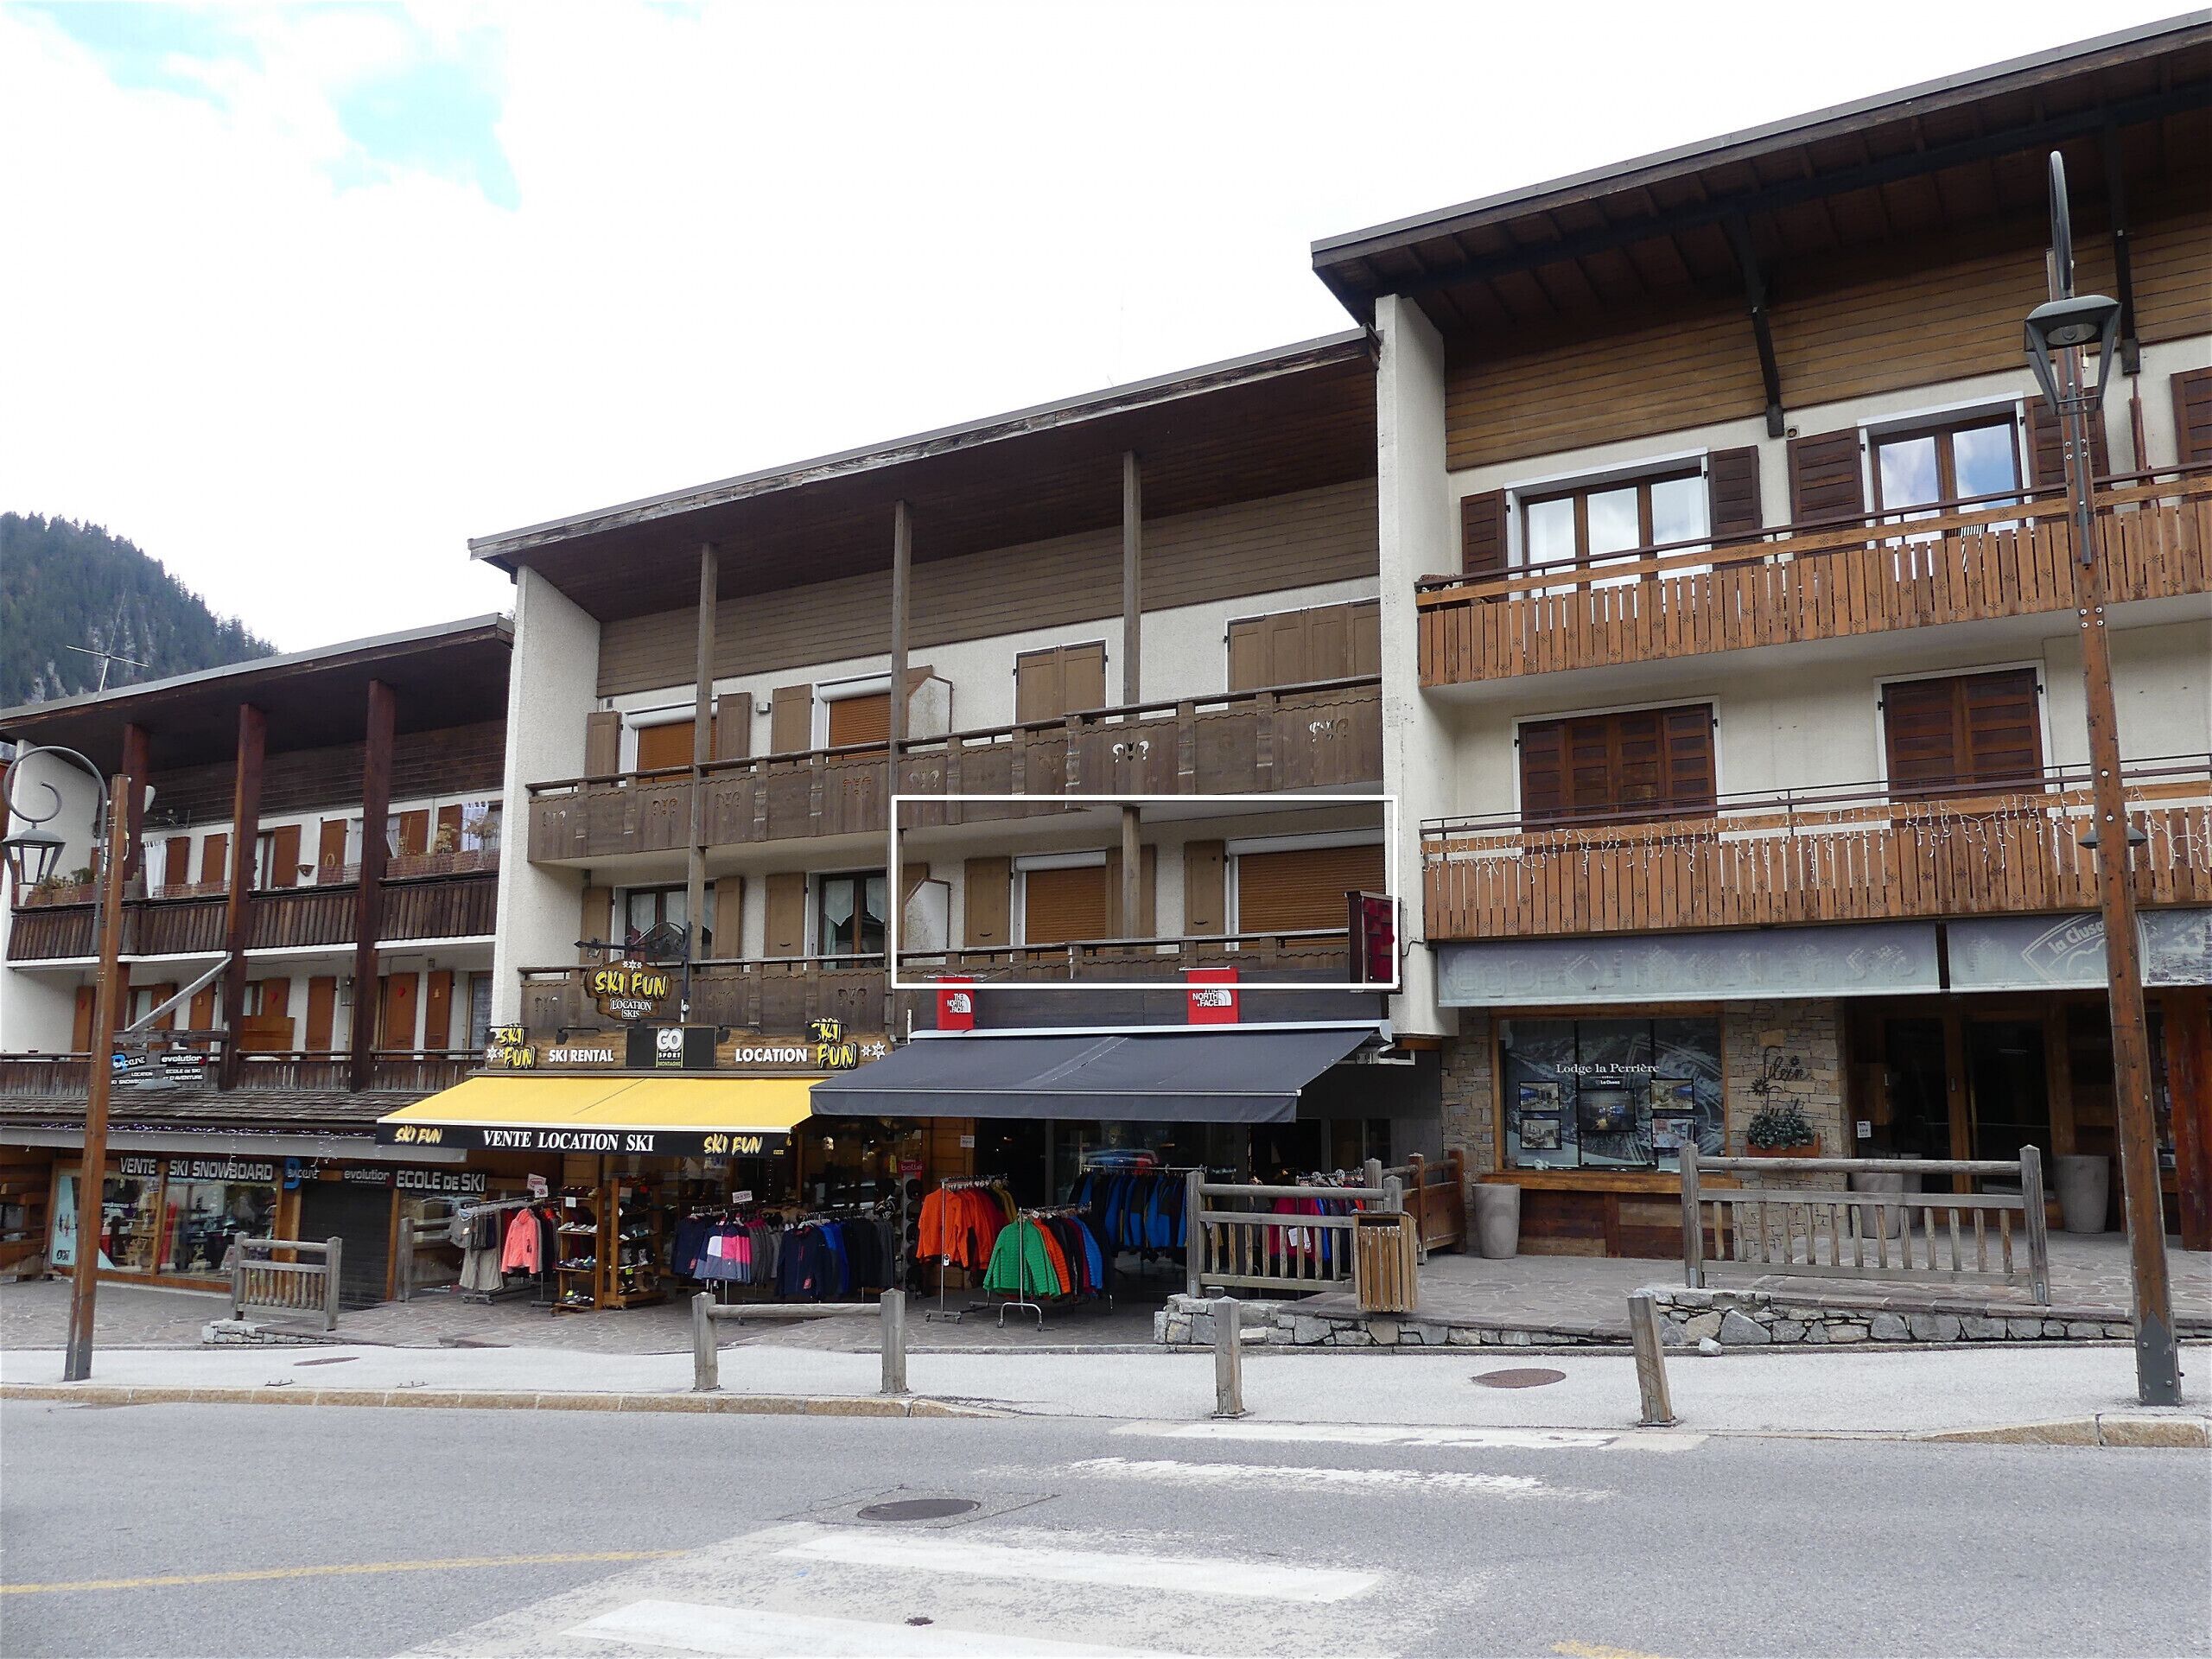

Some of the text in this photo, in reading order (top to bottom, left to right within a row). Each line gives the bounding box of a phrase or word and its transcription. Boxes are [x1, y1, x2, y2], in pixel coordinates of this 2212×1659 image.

[2066, 919, 2104, 944] Clusa
[594, 970, 668, 999] SKI FUN
[610, 999, 652, 1011] LOCATION
[623, 1009, 640, 1018] SKIS
[499, 1025, 524, 1046] SKI
[657, 1028, 683, 1052] GO
[504, 1046, 537, 1069] FUN
[549, 1049, 614, 1063] SKI RENTAL
[735, 1048, 808, 1063] LOCATION
[817, 1042, 858, 1070] FUN
[1556, 1063, 1660, 1075] Lodge la Perrière
[394, 1125, 442, 1145] SKI FUN
[483, 1130, 654, 1152] VENTE LOCATION SKI
[703, 1133, 763, 1156] SKI FUN
[120, 1157, 273, 1181] VENTE SKI SNOWBOARD
[397, 1169, 486, 1192] ECOLE DE SKI
